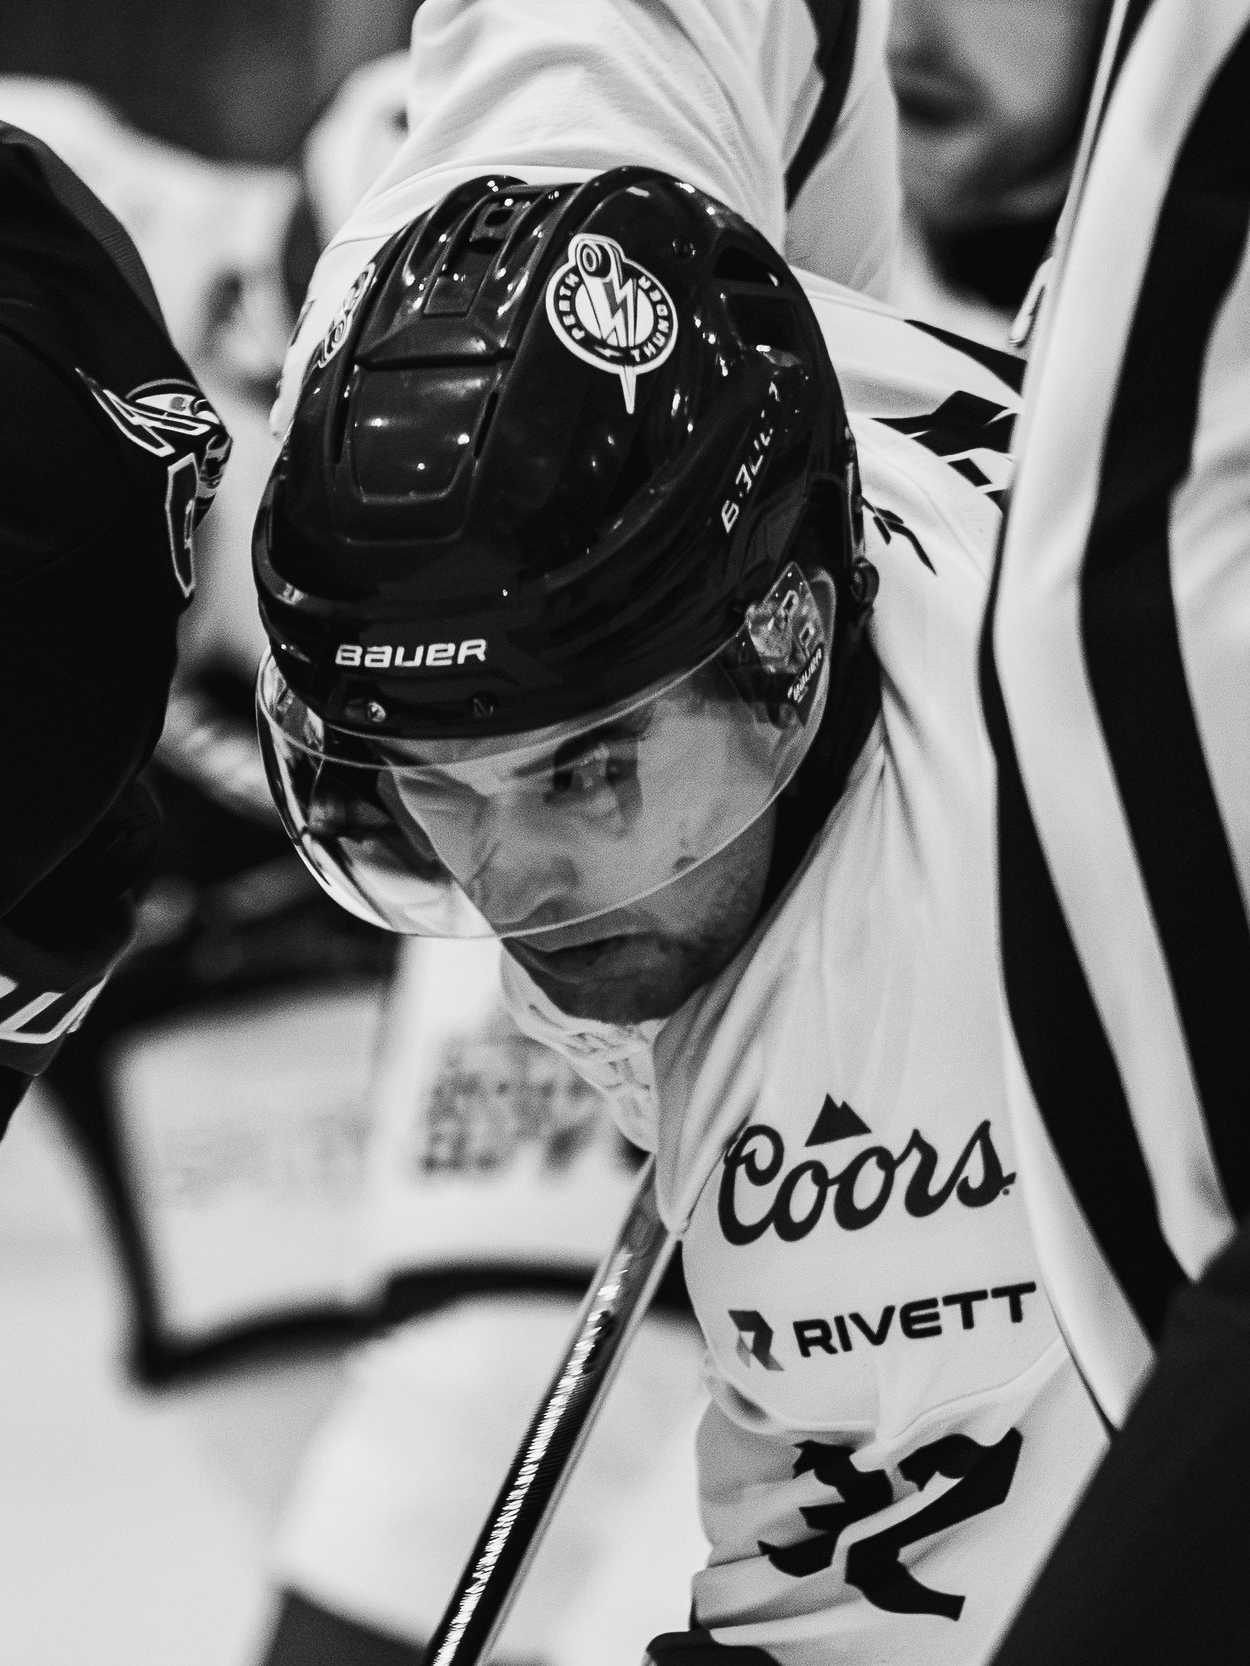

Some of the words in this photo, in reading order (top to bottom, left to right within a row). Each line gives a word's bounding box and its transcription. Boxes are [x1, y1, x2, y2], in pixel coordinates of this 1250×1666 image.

[558, 272, 586, 341] PERTH
[630, 275, 670, 363] THUNDER
[335, 638, 487, 667] BAUER
[717, 1119, 1016, 1247] Coors
[793, 1282, 1037, 1359] RIVETT
